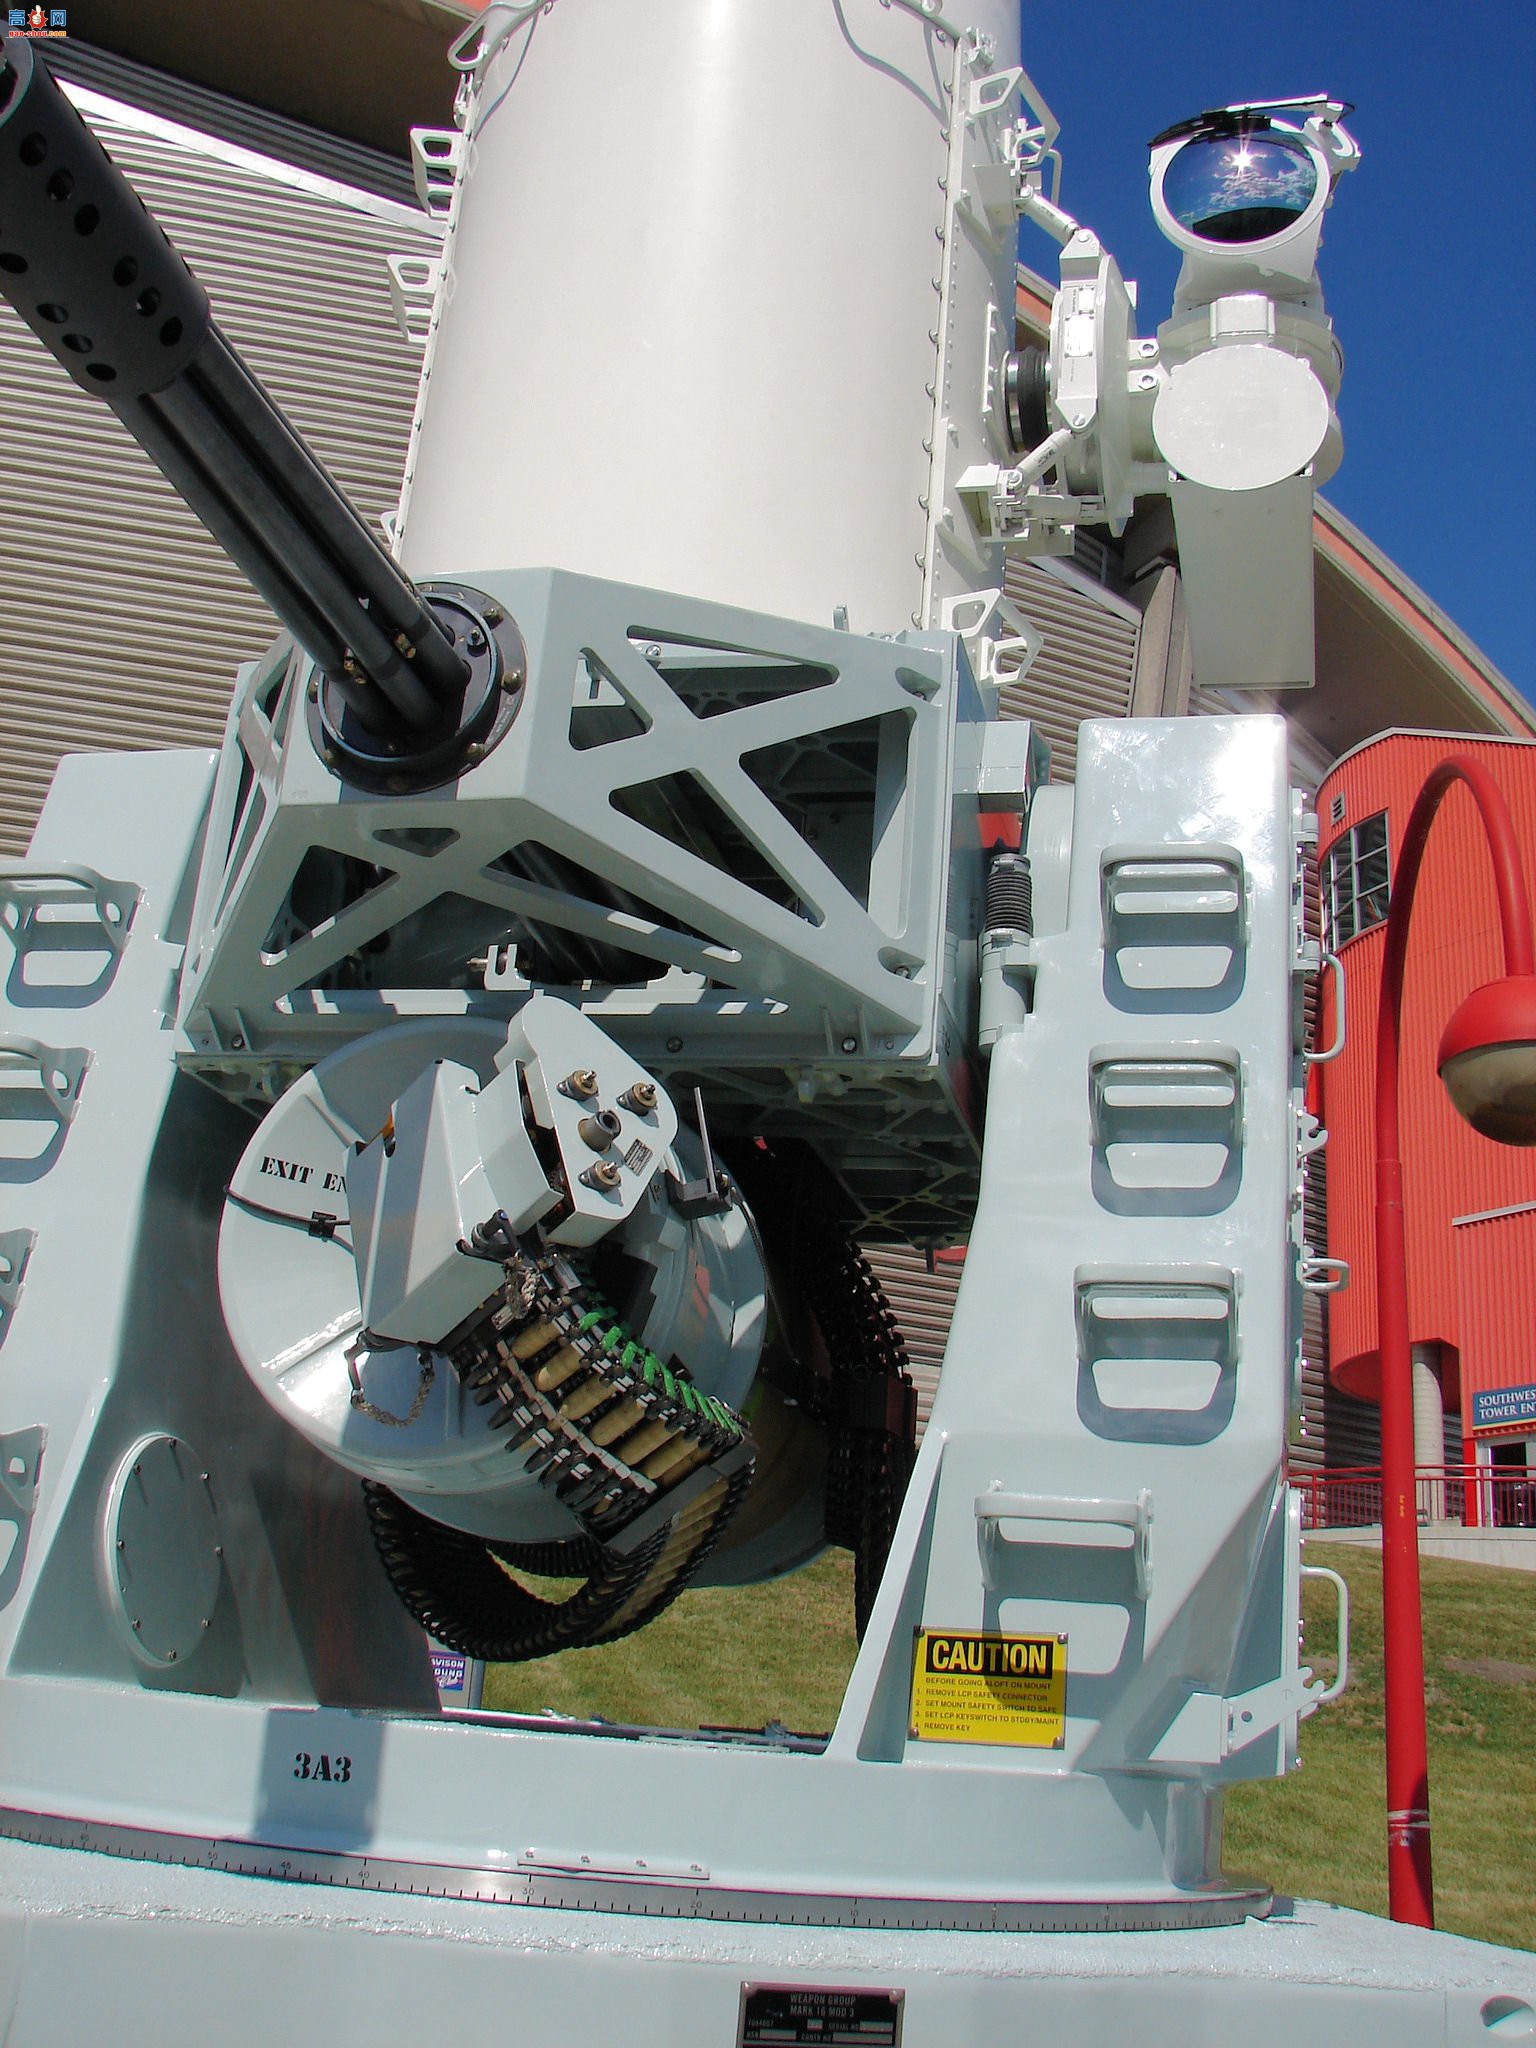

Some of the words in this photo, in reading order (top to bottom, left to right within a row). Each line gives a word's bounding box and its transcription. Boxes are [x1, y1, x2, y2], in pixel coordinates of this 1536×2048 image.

[260, 1156, 314, 1184] EXIT
[1479, 1405, 1518, 1419] TOWER
[932, 1639, 1047, 1676] CAUTION
[925, 1677, 956, 1686] BEFORE
[958, 1679, 983, 1687] GOING
[985, 1680, 1009, 1688] ALOFT
[1011, 1681, 1022, 1689] ON
[1024, 1682, 1051, 1690] MOUNT
[926, 1688, 955, 1697] REMOVE
[958, 1690, 973, 1698] LCP
[974, 1690, 1000, 1699] SAFETY
[1002, 1692, 1048, 1701] CONNECTOR
[940, 1701, 966, 1709] MOUNT
[968, 1702, 995, 1710] SAFETY
[997, 1703, 1025, 1711] SWITCH
[1038, 1706, 1057, 1714] SAFE
[925, 1711, 938, 1719] SET
[940, 1712, 954, 1720] LCP
[956, 1713, 998, 1722] KEYSWITCH
[924, 1722, 954, 1731] REMOVE
[956, 1723, 970, 1732] KEY
[294, 1752, 352, 1783] 3A3
[358, 1869, 370, 1880] 40
[523, 1886, 535, 1896] 30
[790, 1993, 827, 2004] WEAPON
[829, 1995, 856, 2006] GROUP
[790, 2005, 813, 2016] MARK
[828, 2006, 847, 2017] MOD
